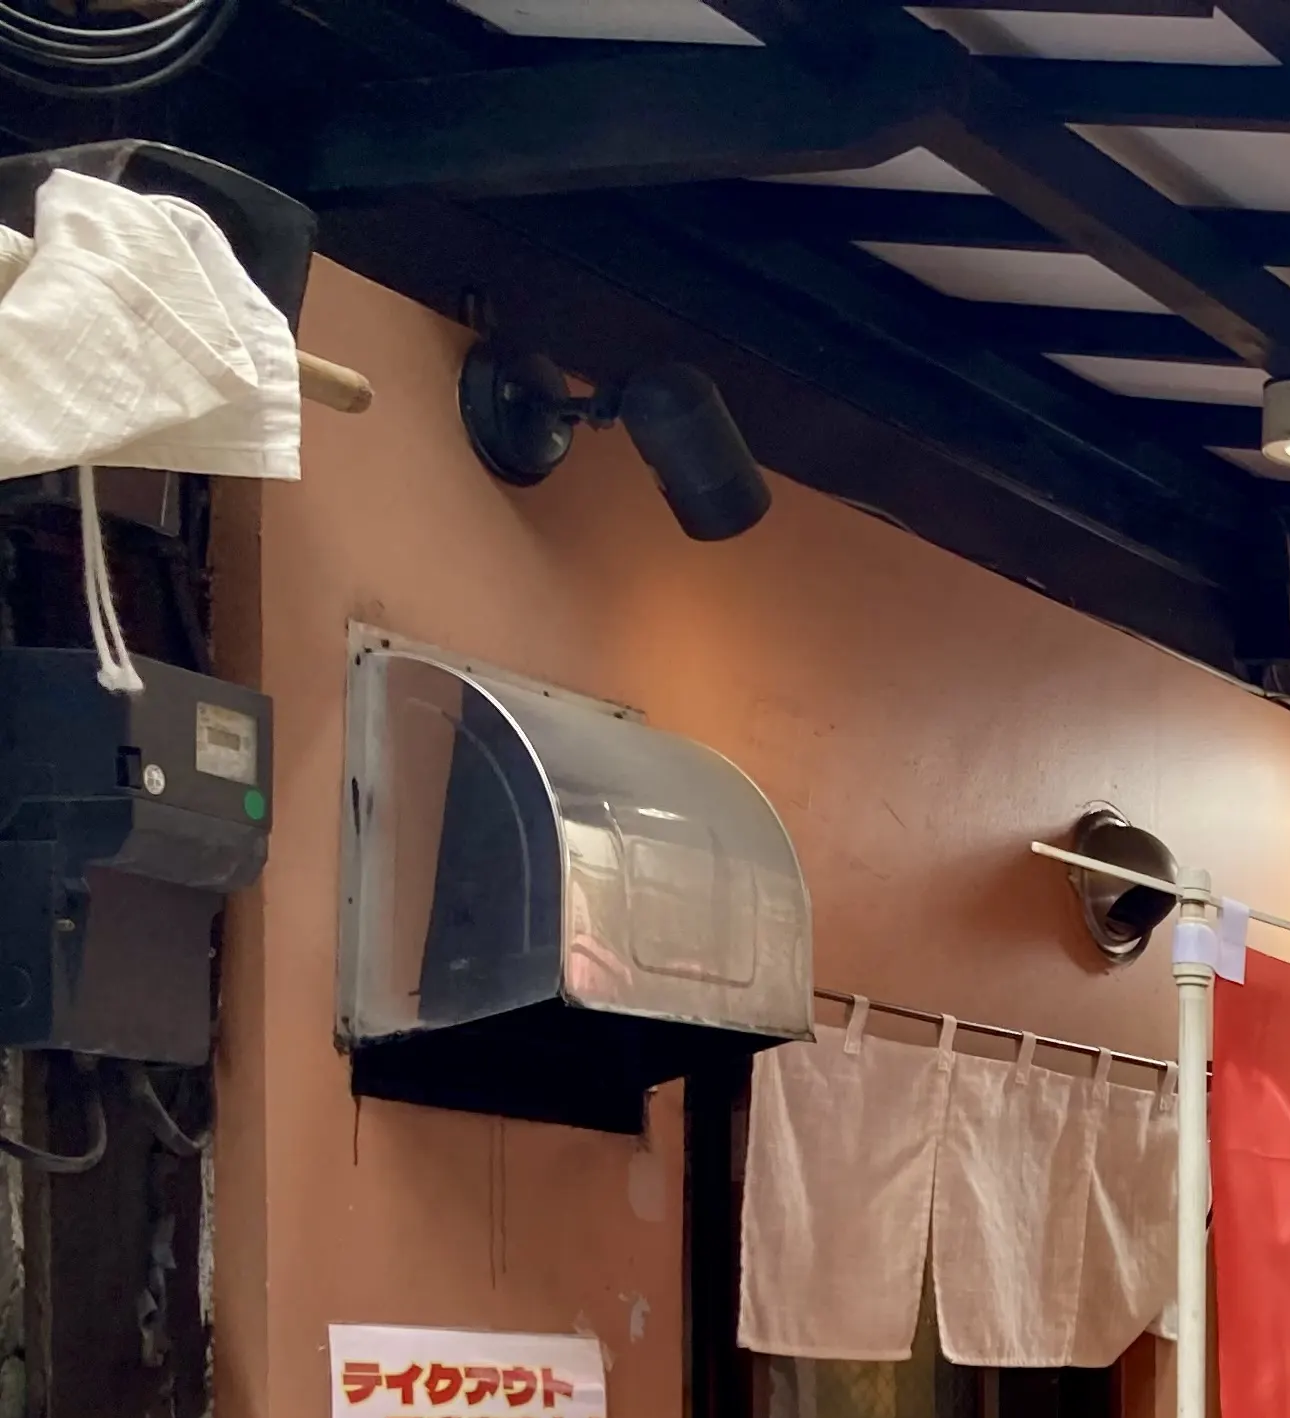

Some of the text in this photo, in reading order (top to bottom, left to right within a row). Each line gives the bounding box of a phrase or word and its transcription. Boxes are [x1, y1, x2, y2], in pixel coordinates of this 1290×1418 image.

[342, 1361, 574, 1408] テイクアウト
